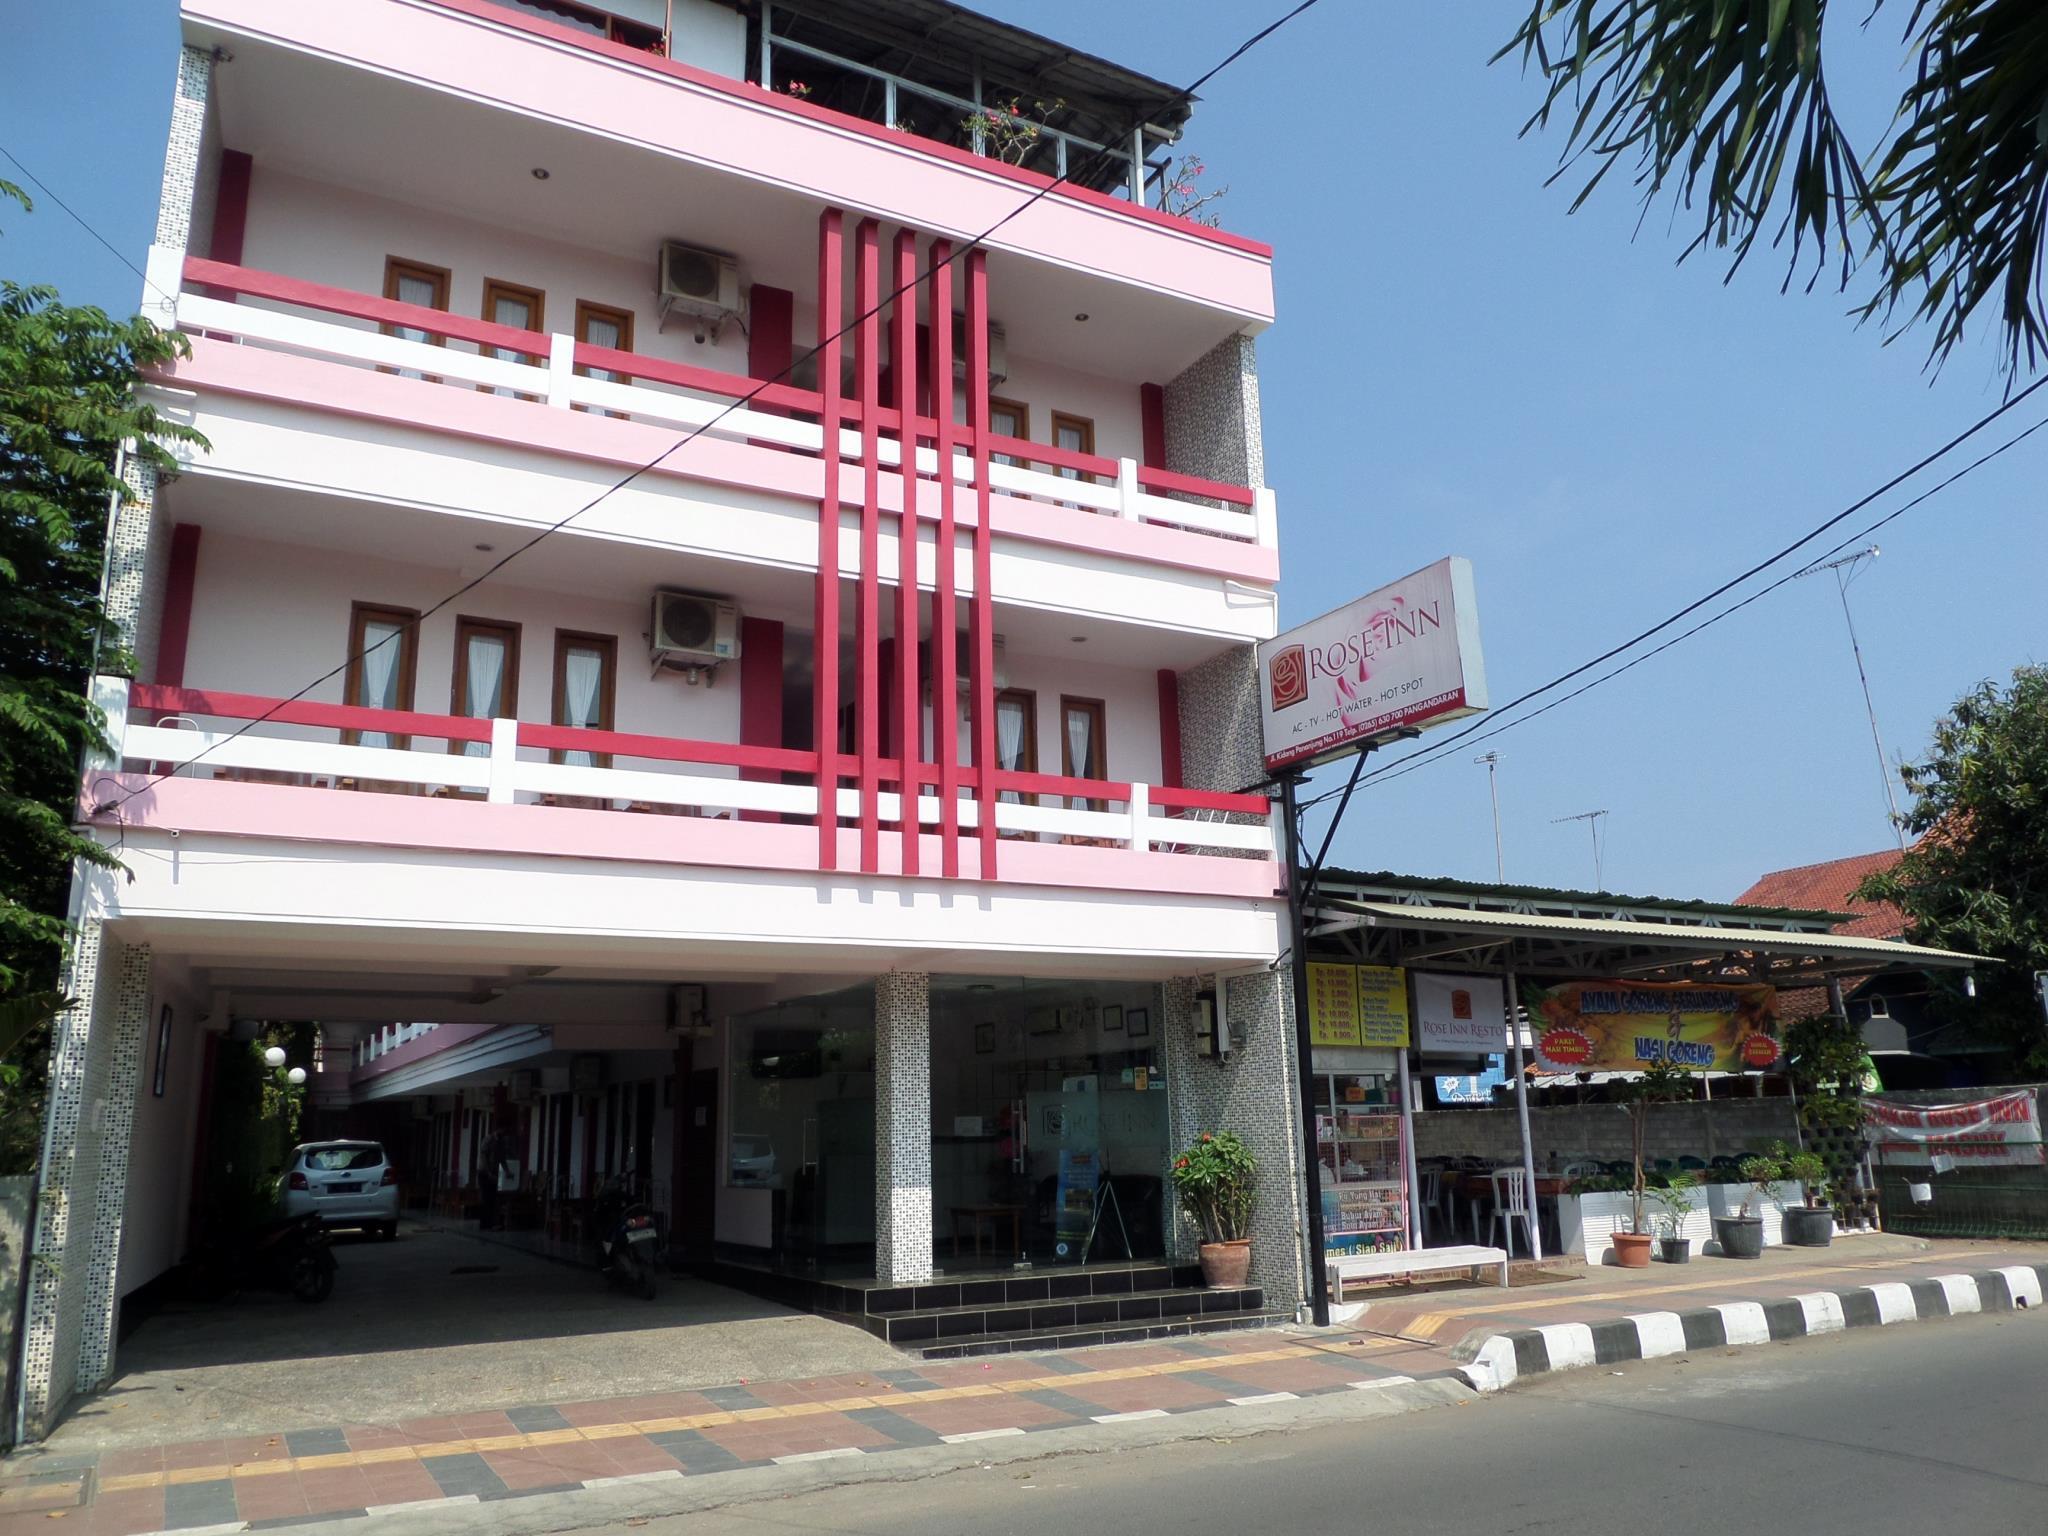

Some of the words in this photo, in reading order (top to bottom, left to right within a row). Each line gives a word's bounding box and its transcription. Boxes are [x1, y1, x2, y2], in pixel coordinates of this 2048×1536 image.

[1309, 630, 1375, 680] ROSE
[1383, 600, 1441, 649] INN
[1292, 722, 1303, 734] AC
[1308, 717, 1319, 729] TV
[1326, 709, 1343, 723] HOT
[1343, 698, 1373, 713] WATER
[1380, 687, 1398, 701] HOT
[1401, 678, 1425, 696] SPOT
[1378, 713, 1391, 726] 630
[1391, 708, 1404, 722] 700
[1404, 690, 1459, 718] PANGANDARAN
[1423, 1021, 1447, 1036] ROSE
[1450, 1022, 1468, 1035] INN
[1471, 1023, 1504, 1038] RESTO
[1634, 1036, 1664, 1062] NASI
[1667, 1038, 1715, 1067] GORENG
